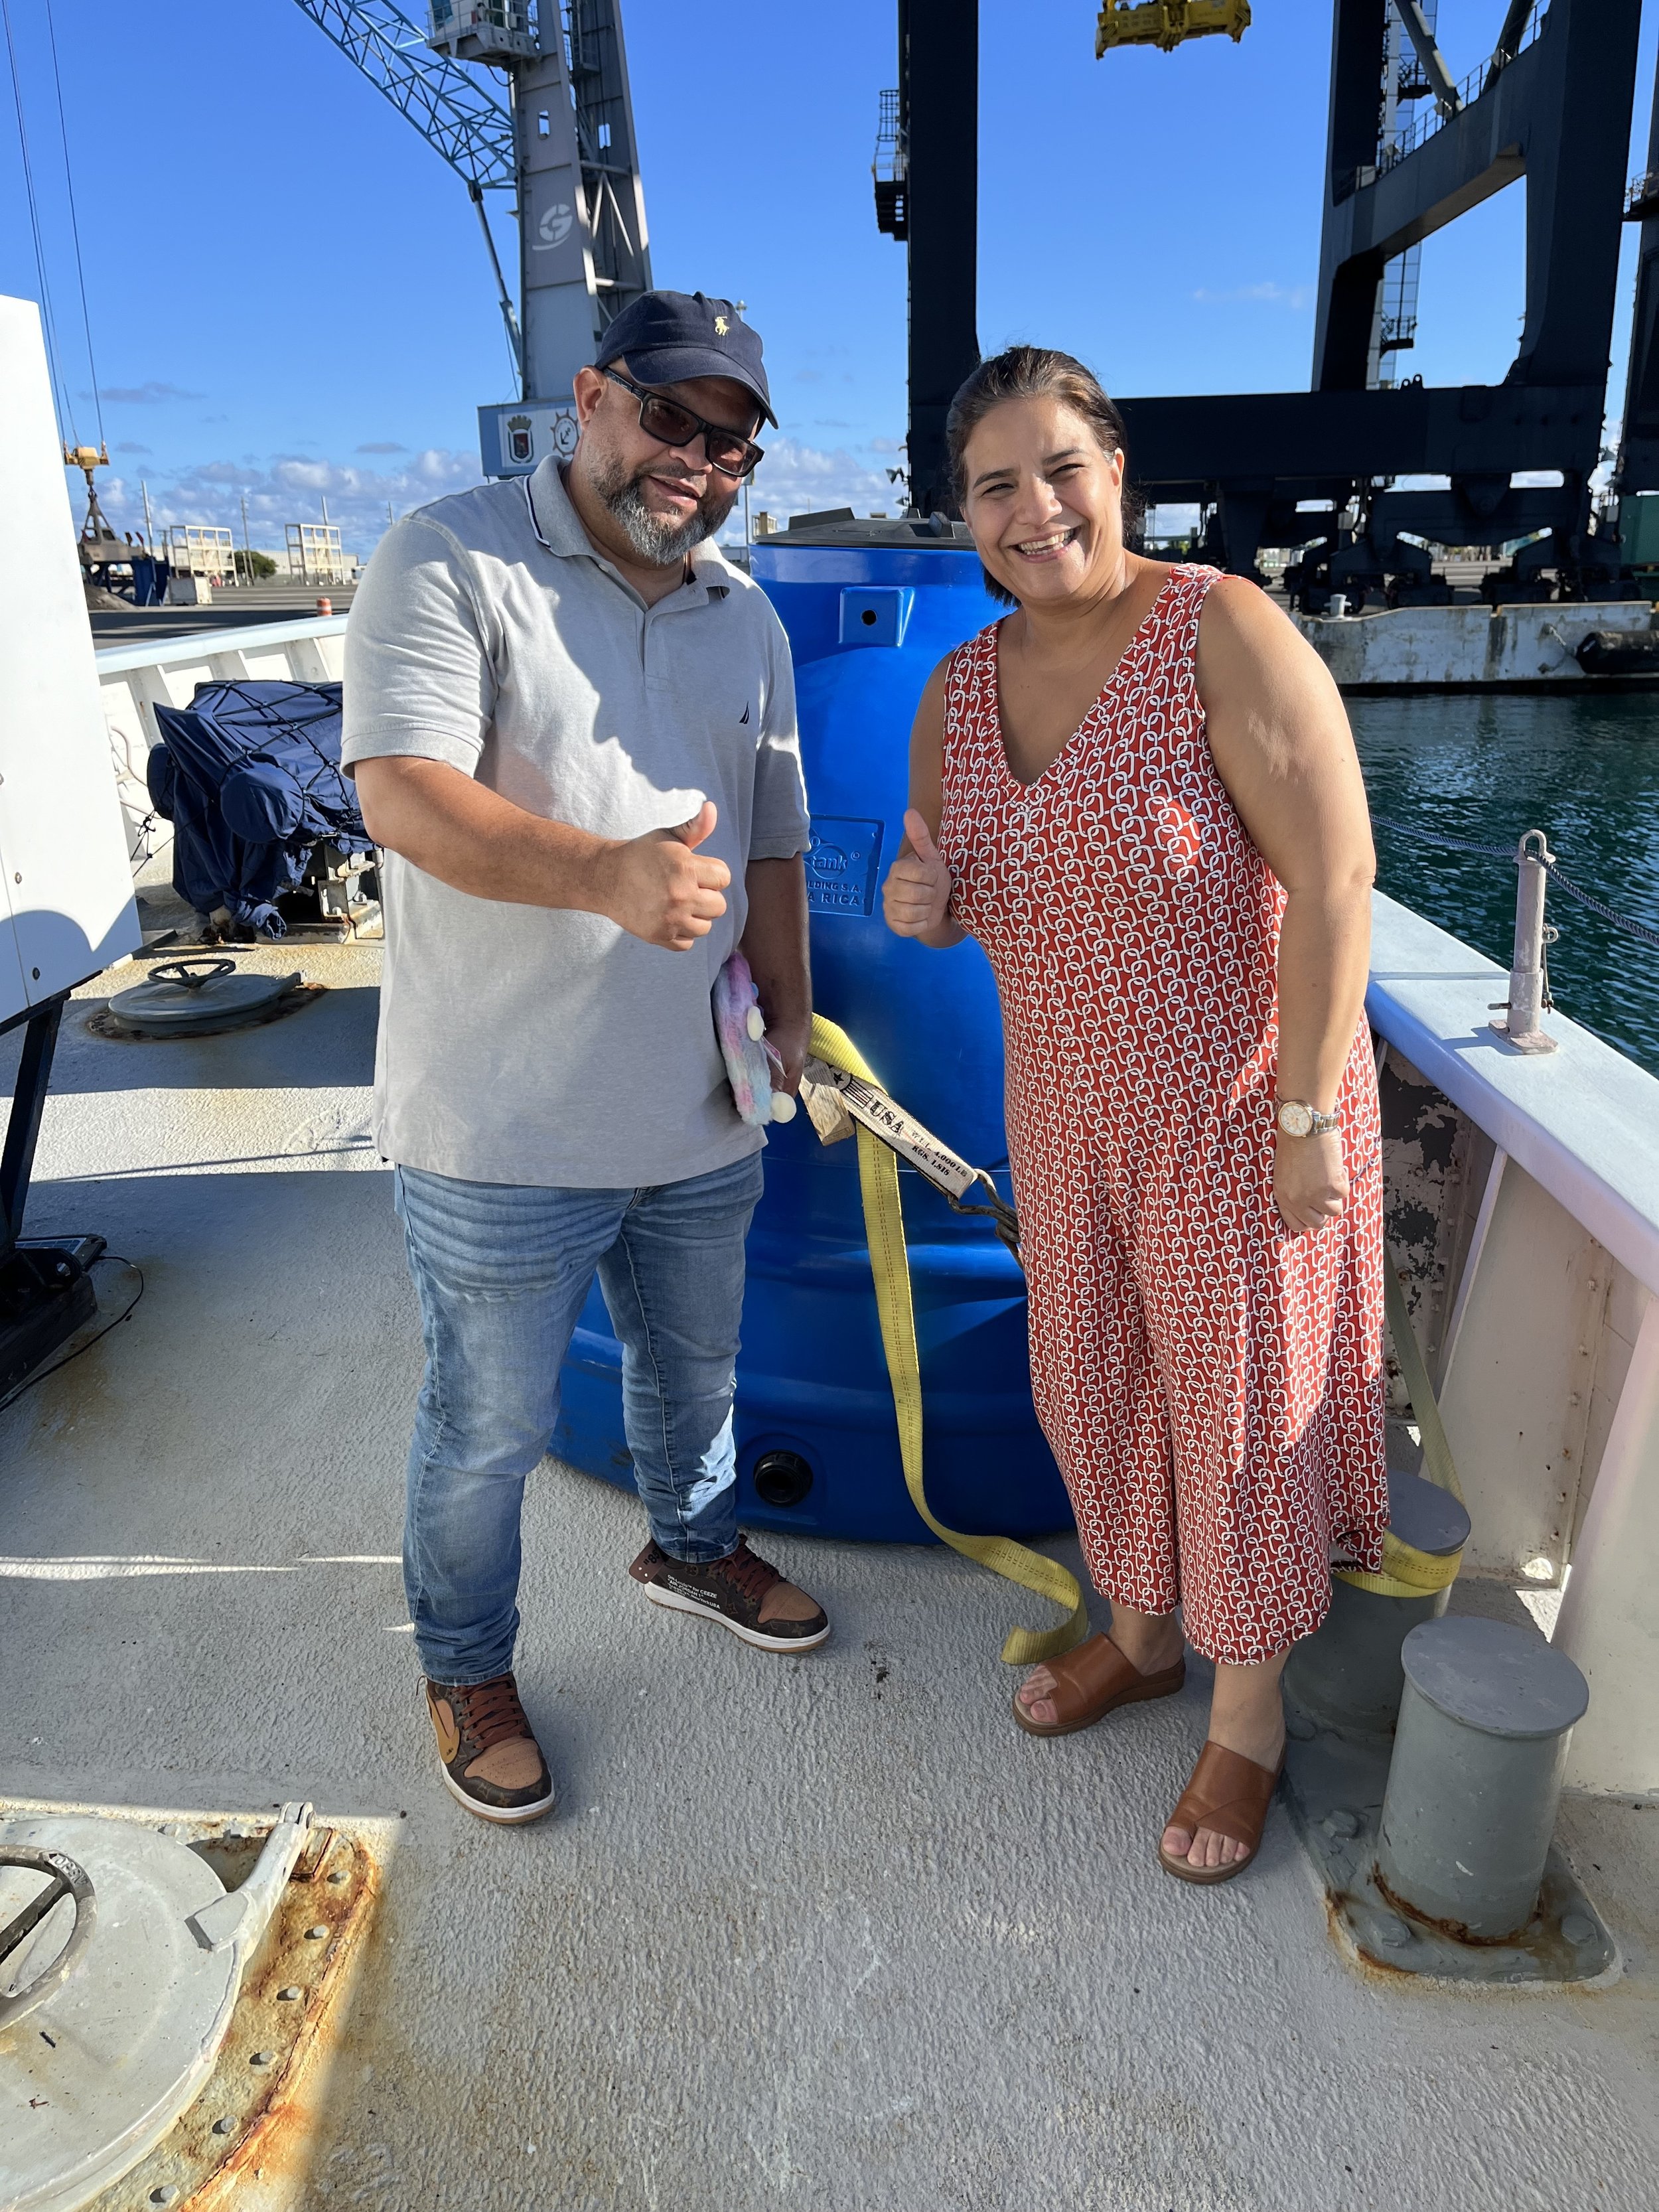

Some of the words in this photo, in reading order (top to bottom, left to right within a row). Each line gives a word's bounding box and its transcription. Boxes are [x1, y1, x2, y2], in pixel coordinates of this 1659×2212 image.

[806, 881, 839, 891] LDING
[821, 892, 861, 907] RICA
[870, 1099, 904, 1137] USA
